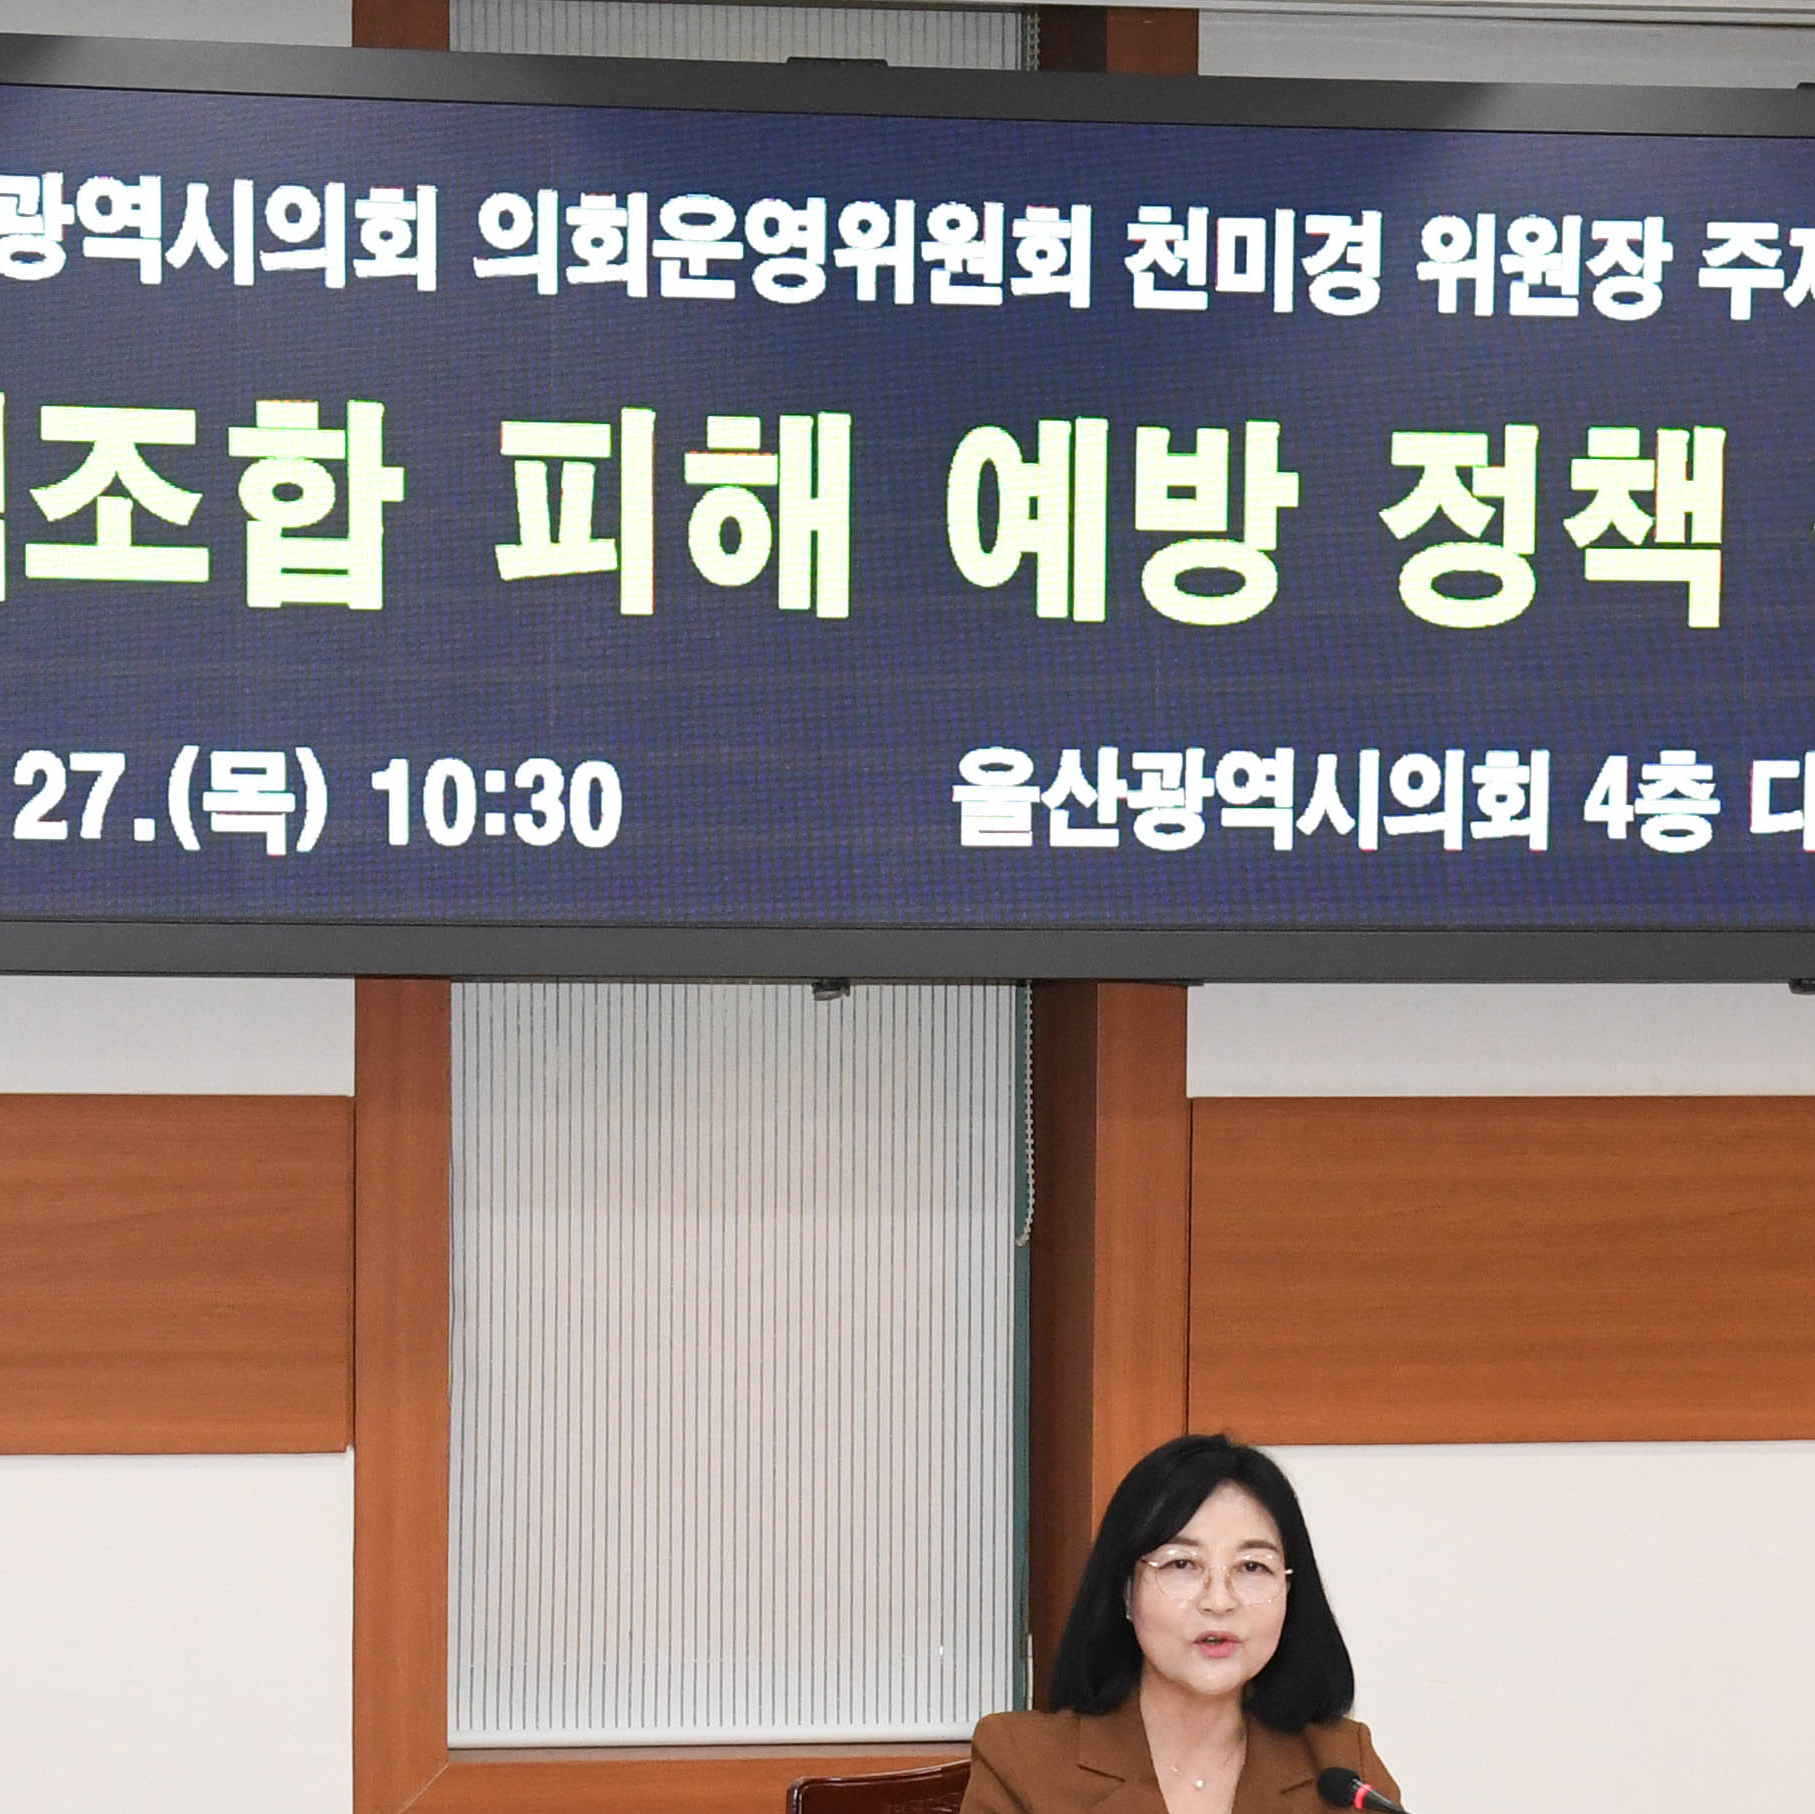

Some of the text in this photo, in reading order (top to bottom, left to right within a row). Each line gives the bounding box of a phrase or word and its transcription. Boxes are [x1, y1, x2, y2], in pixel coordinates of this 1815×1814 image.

[474, 190, 1090, 307] 의회운영위원회
[1125, 207, 1381, 315] 천미경
[1417, 214, 1672, 320] 위원장
[496, 409, 850, 617] 피해
[948, 419, 1298, 624] 예방
[1381, 426, 1725, 627] 정책
[14, 746, 326, 854] 27.(목)
[372, 759, 621, 847] 10:30
[953, 748, 1549, 850] 울산광역시의회
[1585, 751, 1720, 852] 4층
